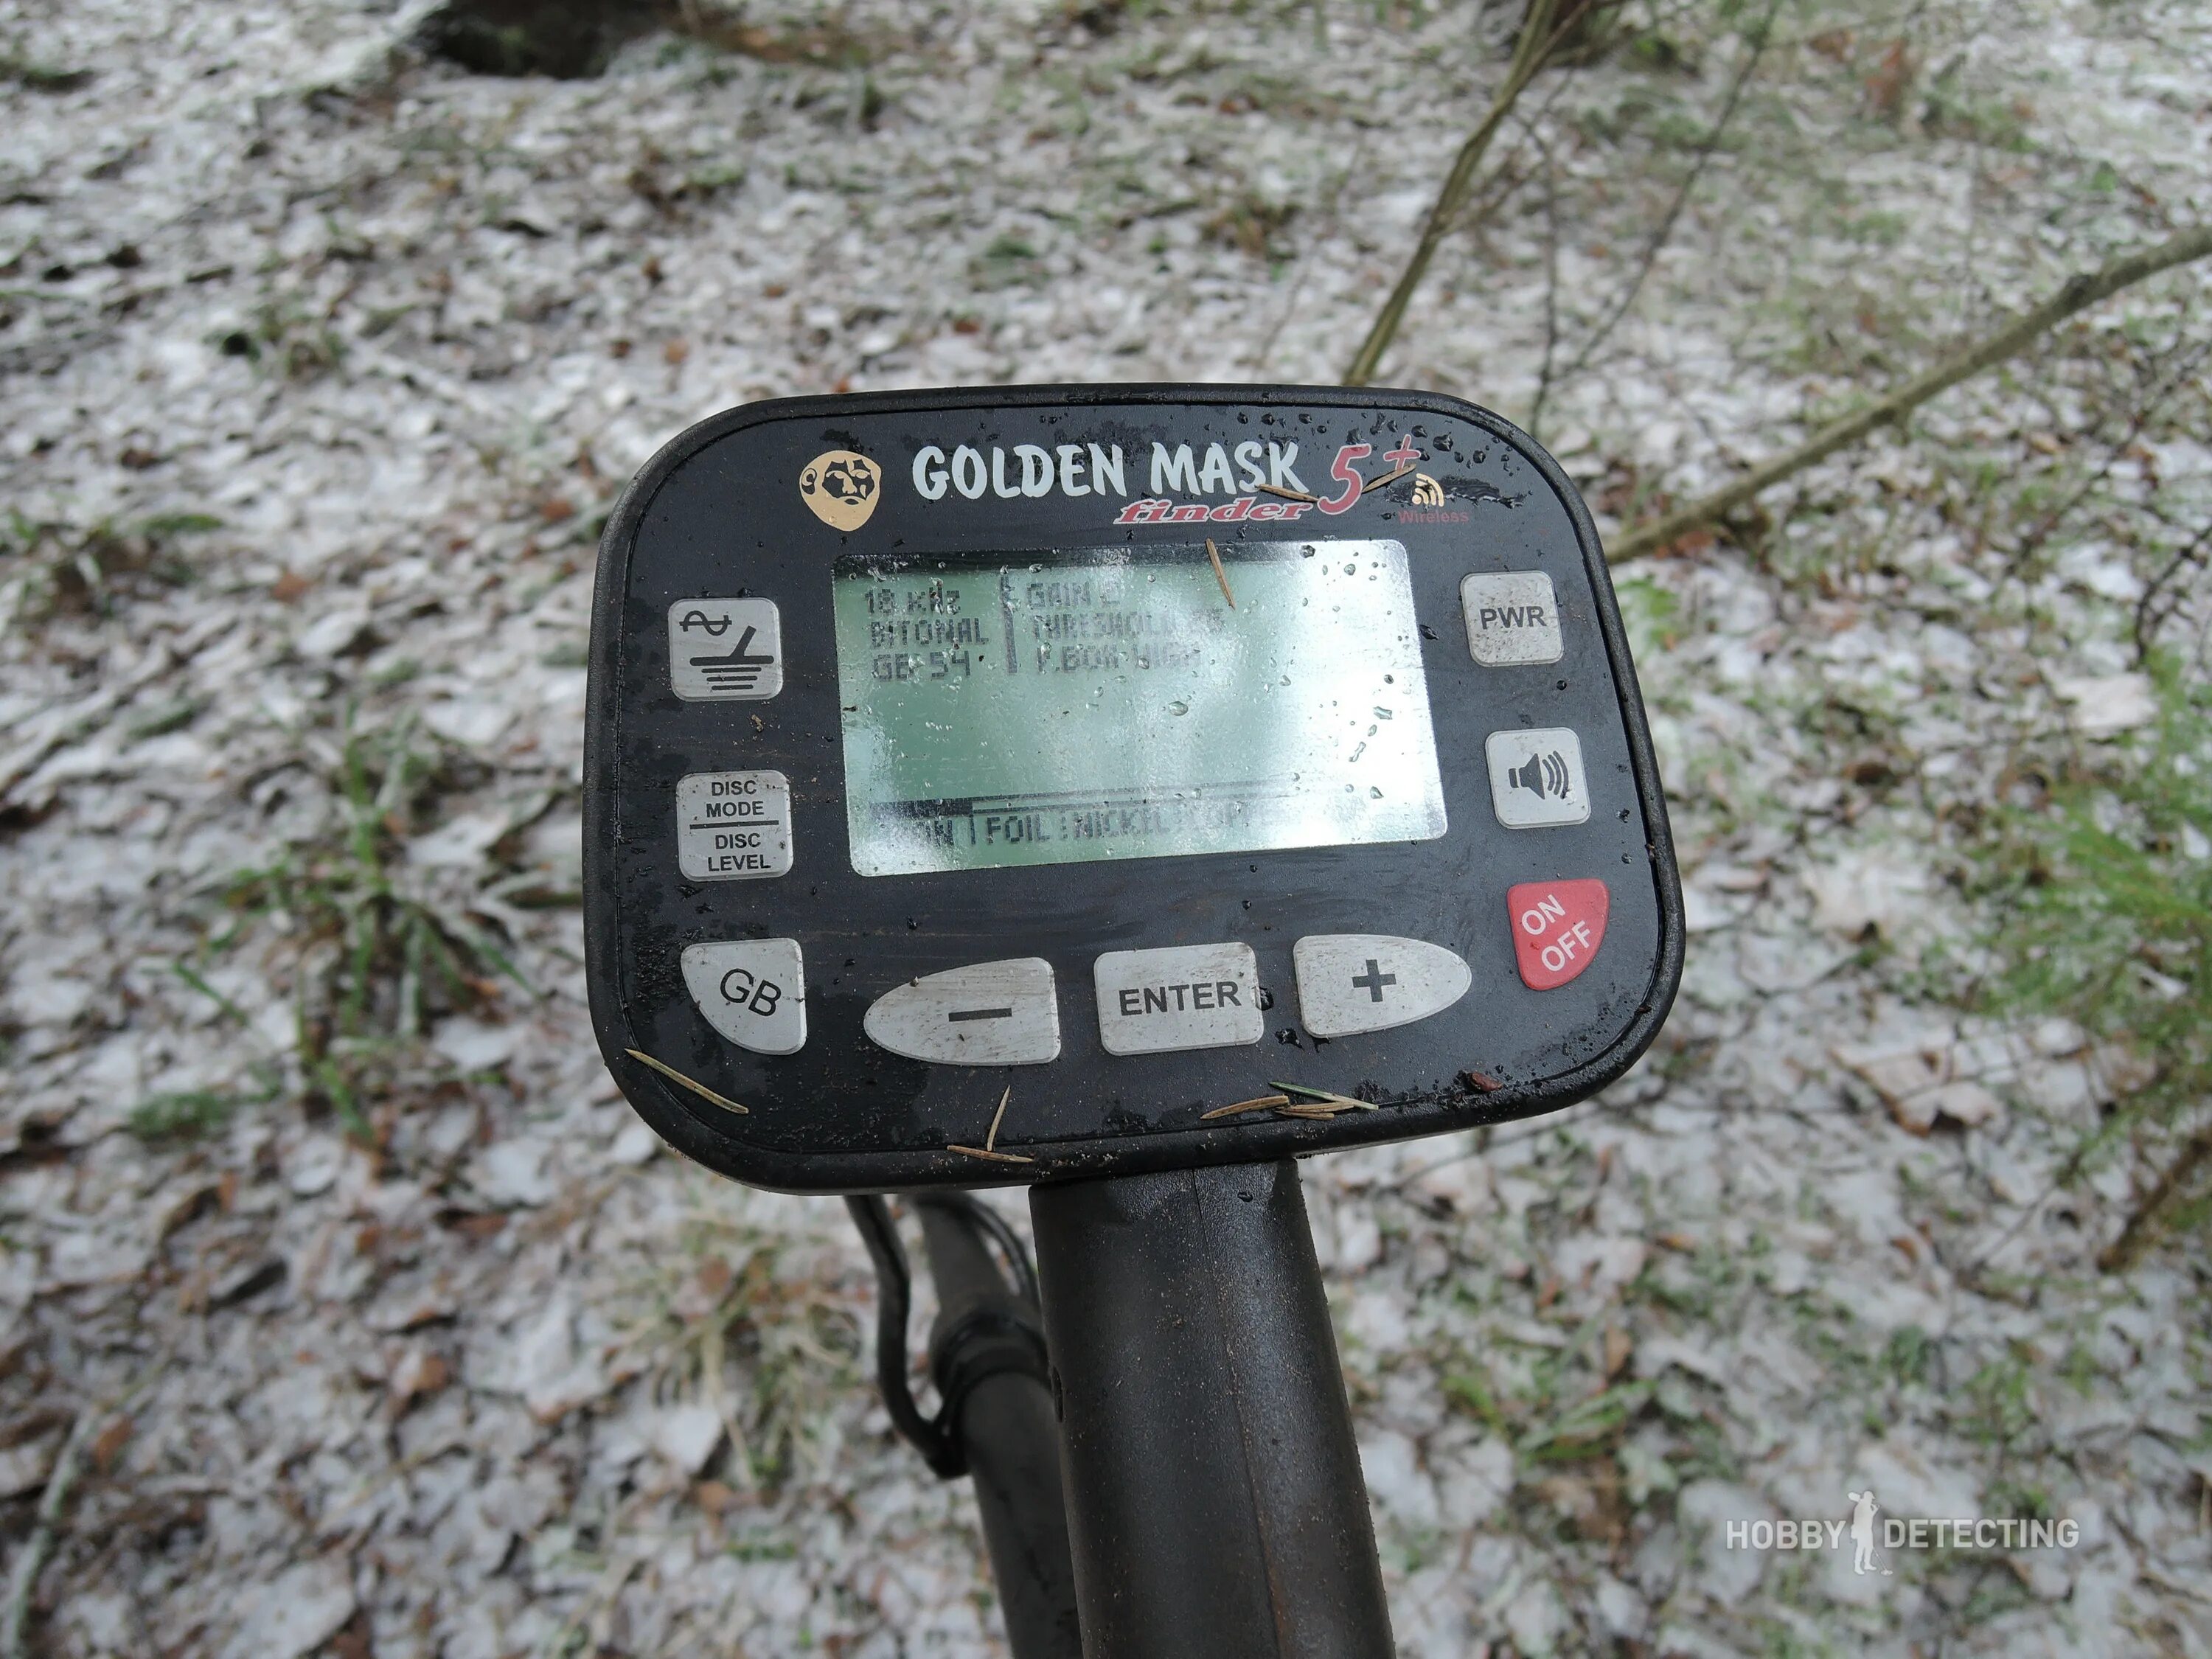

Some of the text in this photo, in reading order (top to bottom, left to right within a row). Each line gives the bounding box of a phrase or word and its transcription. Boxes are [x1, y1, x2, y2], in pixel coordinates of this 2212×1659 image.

[912, 442, 1310, 499] GOLDEN MASK
[1112, 495, 1314, 525] finder
[1397, 509, 1470, 524] Wireless
[1027, 580, 1092, 608] GAIN
[871, 617, 990, 648] BITONAL
[1479, 605, 1547, 630] PWR
[711, 779, 757, 796] DISC
[706, 800, 765, 818] MODE
[1071, 808, 1171, 839] NICKEL
[714, 832, 762, 850] DISC
[987, 813, 1051, 844] FOIL
[707, 854, 772, 872] LEVEL
[1521, 894, 1566, 936] ON
[1541, 919, 1590, 972] OFF
[720, 967, 782, 1017] GB
[1119, 981, 1242, 1016] ENTER
